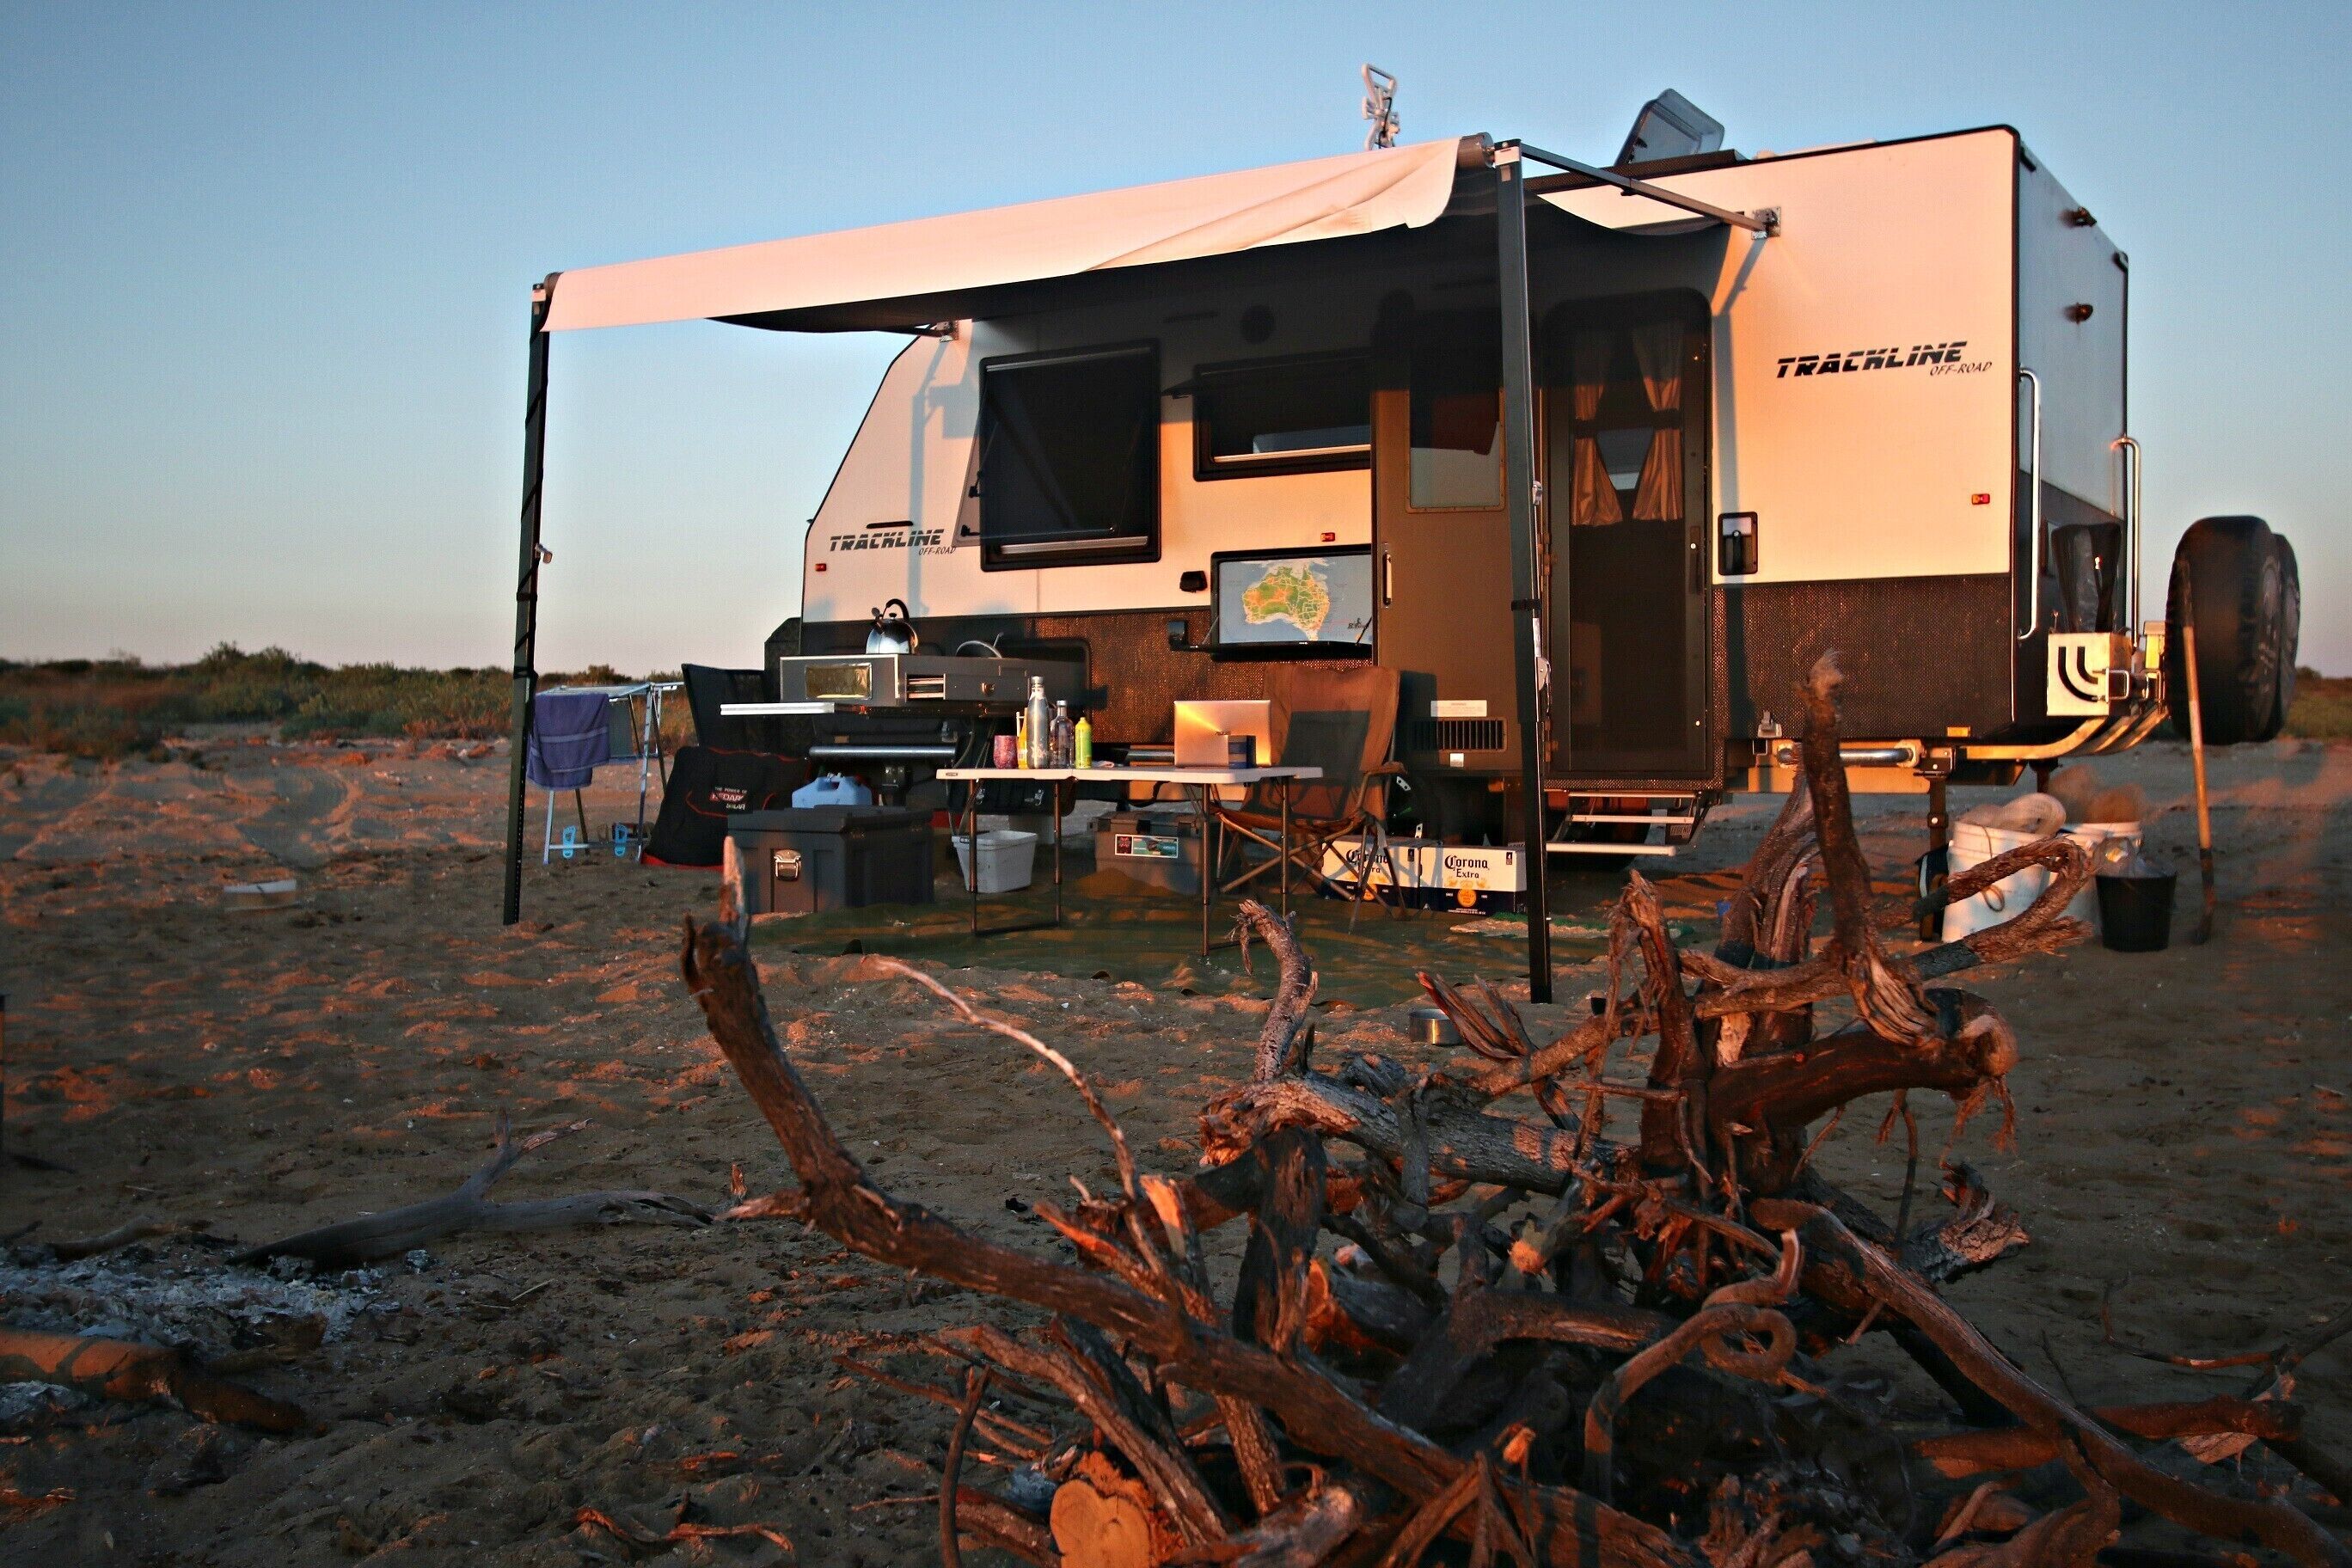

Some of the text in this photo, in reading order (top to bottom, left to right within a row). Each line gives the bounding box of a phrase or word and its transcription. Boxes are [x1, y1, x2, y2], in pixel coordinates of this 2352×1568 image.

[1776, 340, 1968, 378] TRACKLINE
[1929, 361, 1993, 377] OFF-ROAD
[830, 529, 945, 552] TRACKLINE
[918, 546, 957, 556] OFF-ROAD
[1346, 848, 1388, 865] Corna
[1444, 854, 1489, 871] Corona
[1455, 868, 1479, 879] Extra
